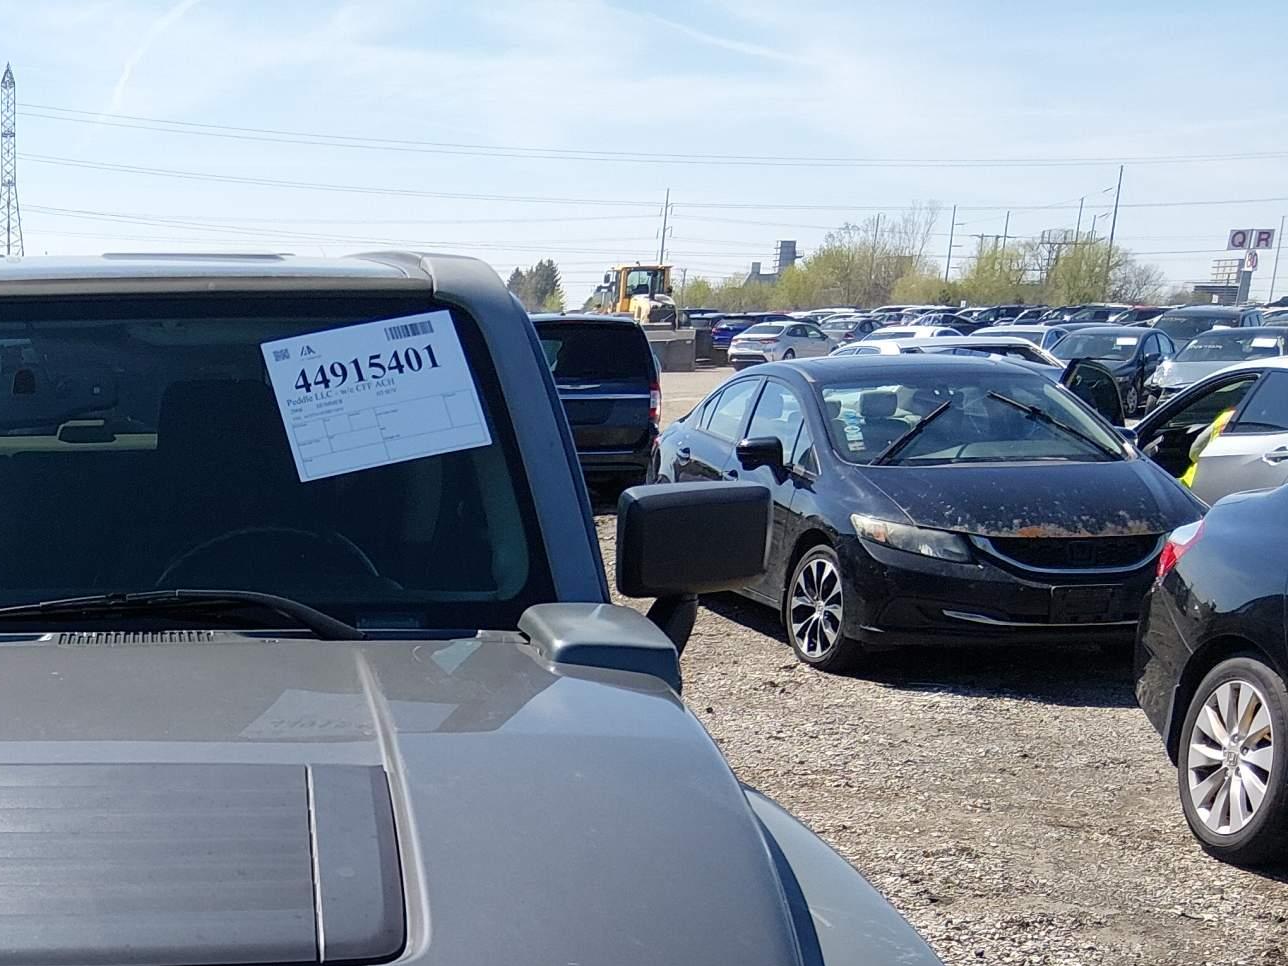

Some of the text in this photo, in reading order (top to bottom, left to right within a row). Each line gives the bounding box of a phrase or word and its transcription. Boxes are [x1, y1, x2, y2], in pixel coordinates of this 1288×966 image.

[1231, 231, 1271, 247] Q R
[294, 344, 441, 393] 44915401
[286, 395, 313, 407] Peddle
[314, 388, 333, 401] LLC
[375, 377, 396, 388] ACH
